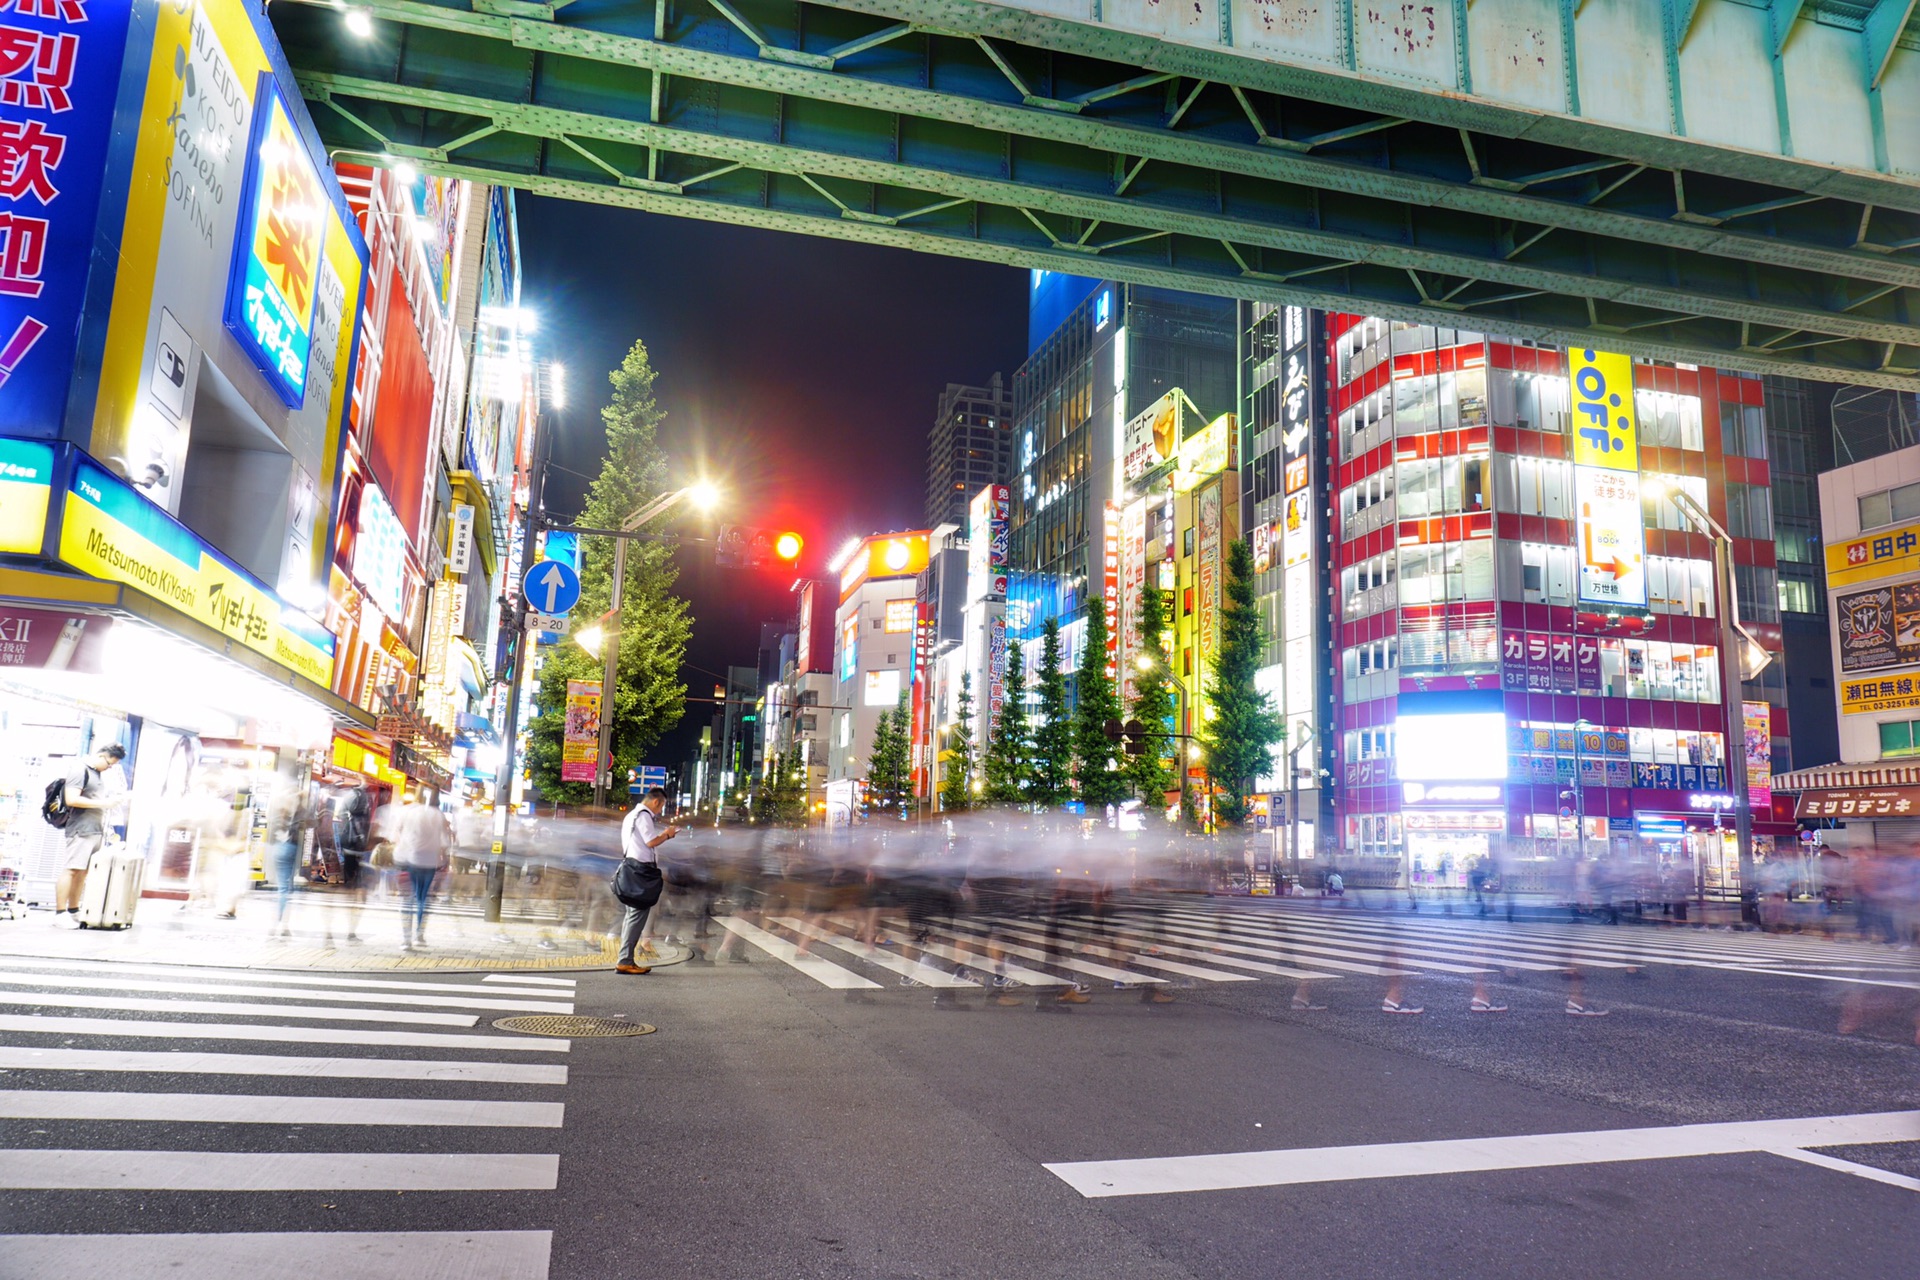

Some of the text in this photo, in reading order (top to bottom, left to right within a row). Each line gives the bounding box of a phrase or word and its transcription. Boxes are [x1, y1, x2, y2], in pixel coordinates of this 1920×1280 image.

[166, 101, 224, 206] Kanebo
[163, 156, 213, 250] SOFINA
[310, 331, 339, 389] Kanebo
[307, 370, 333, 421] SOFINA
[1576, 366, 1610, 453] OFF
[1873, 532, 1917, 560] 田中
[86, 527, 197, 608] Matsumoto KiYoshi
[1592, 582, 1620, 596] 万世橋
[1504, 637, 1596, 664] カラオケ
[1506, 673, 1524, 684] 3F
[1529, 675, 1550, 687] 受付
[1273, 796, 1283, 808] P
[1806, 798, 1912, 814] ミツワデンキ
